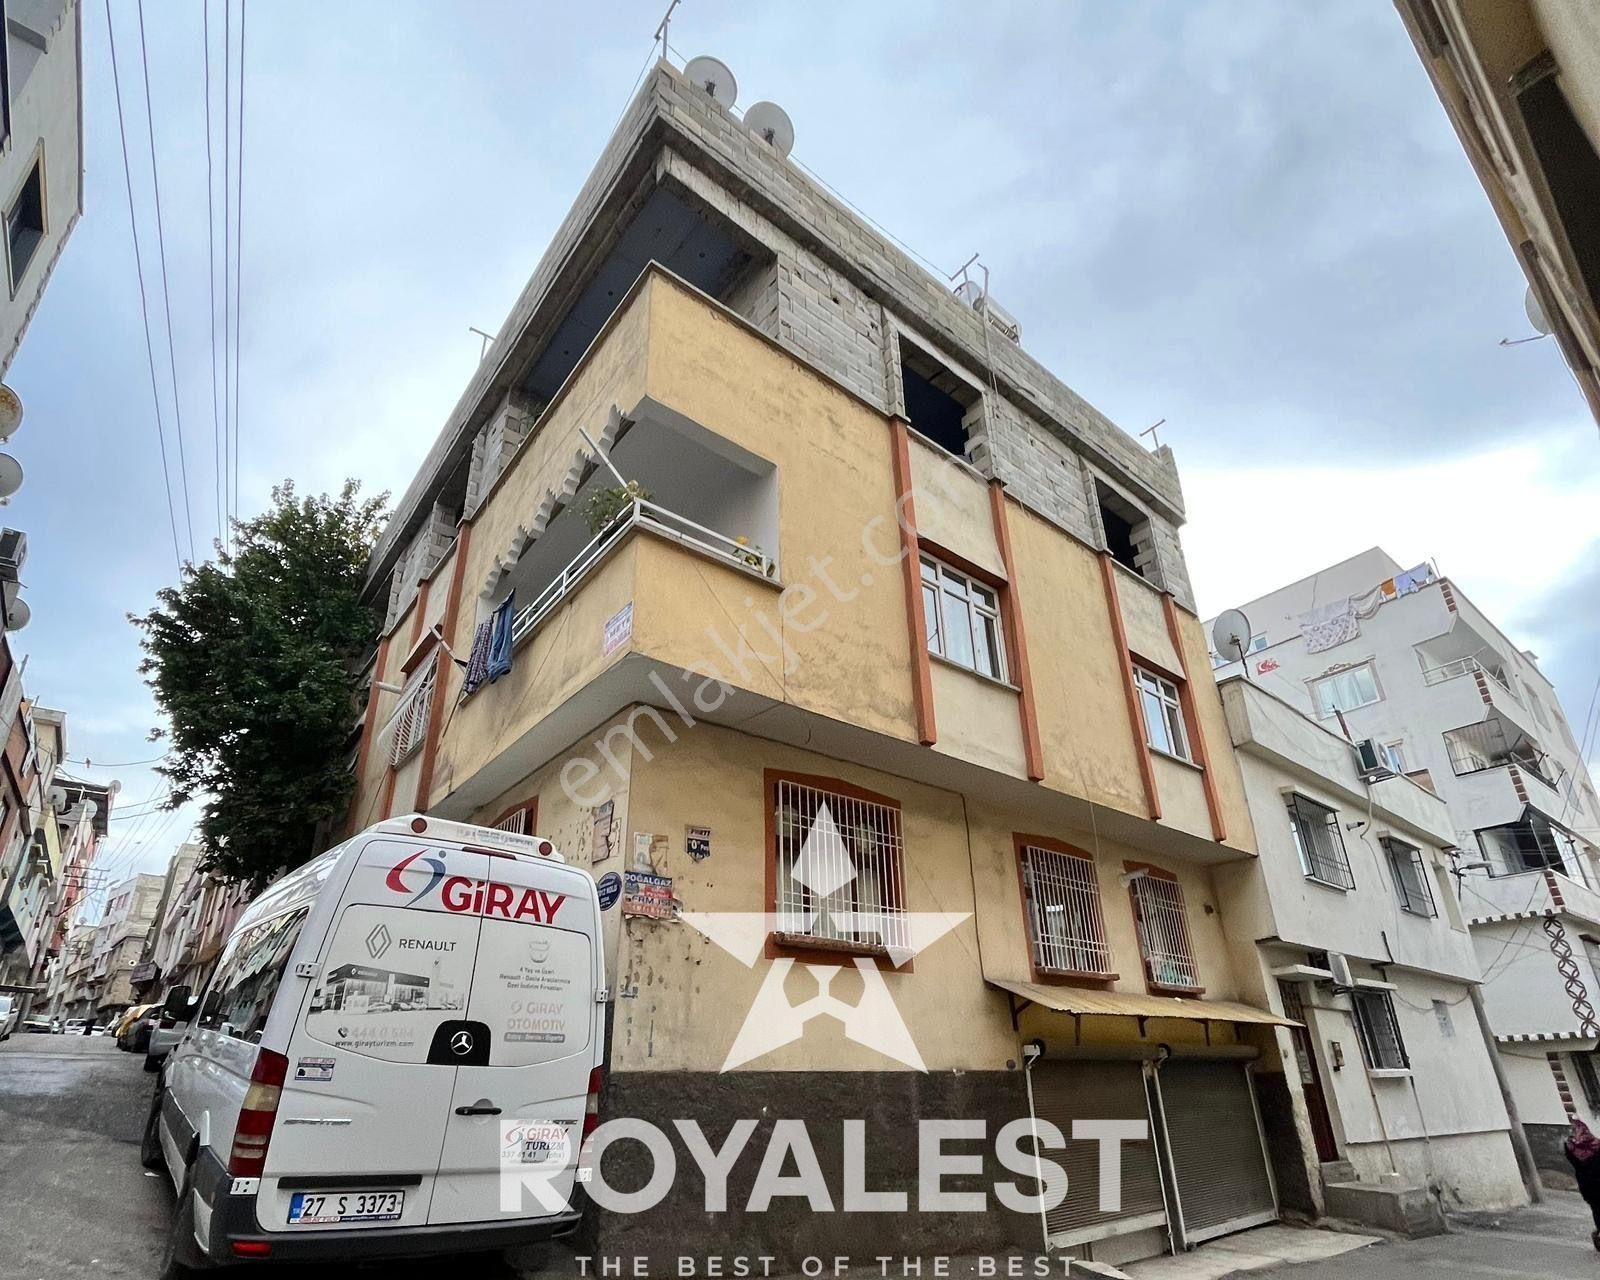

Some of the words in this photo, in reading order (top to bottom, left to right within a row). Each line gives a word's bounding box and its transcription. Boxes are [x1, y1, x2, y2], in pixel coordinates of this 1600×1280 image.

[399, 938, 457, 951] RENAULT
[303, 1197, 326, 1216] 27
[337, 1196, 348, 1214] S
[356, 1194, 397, 1214] 3373
